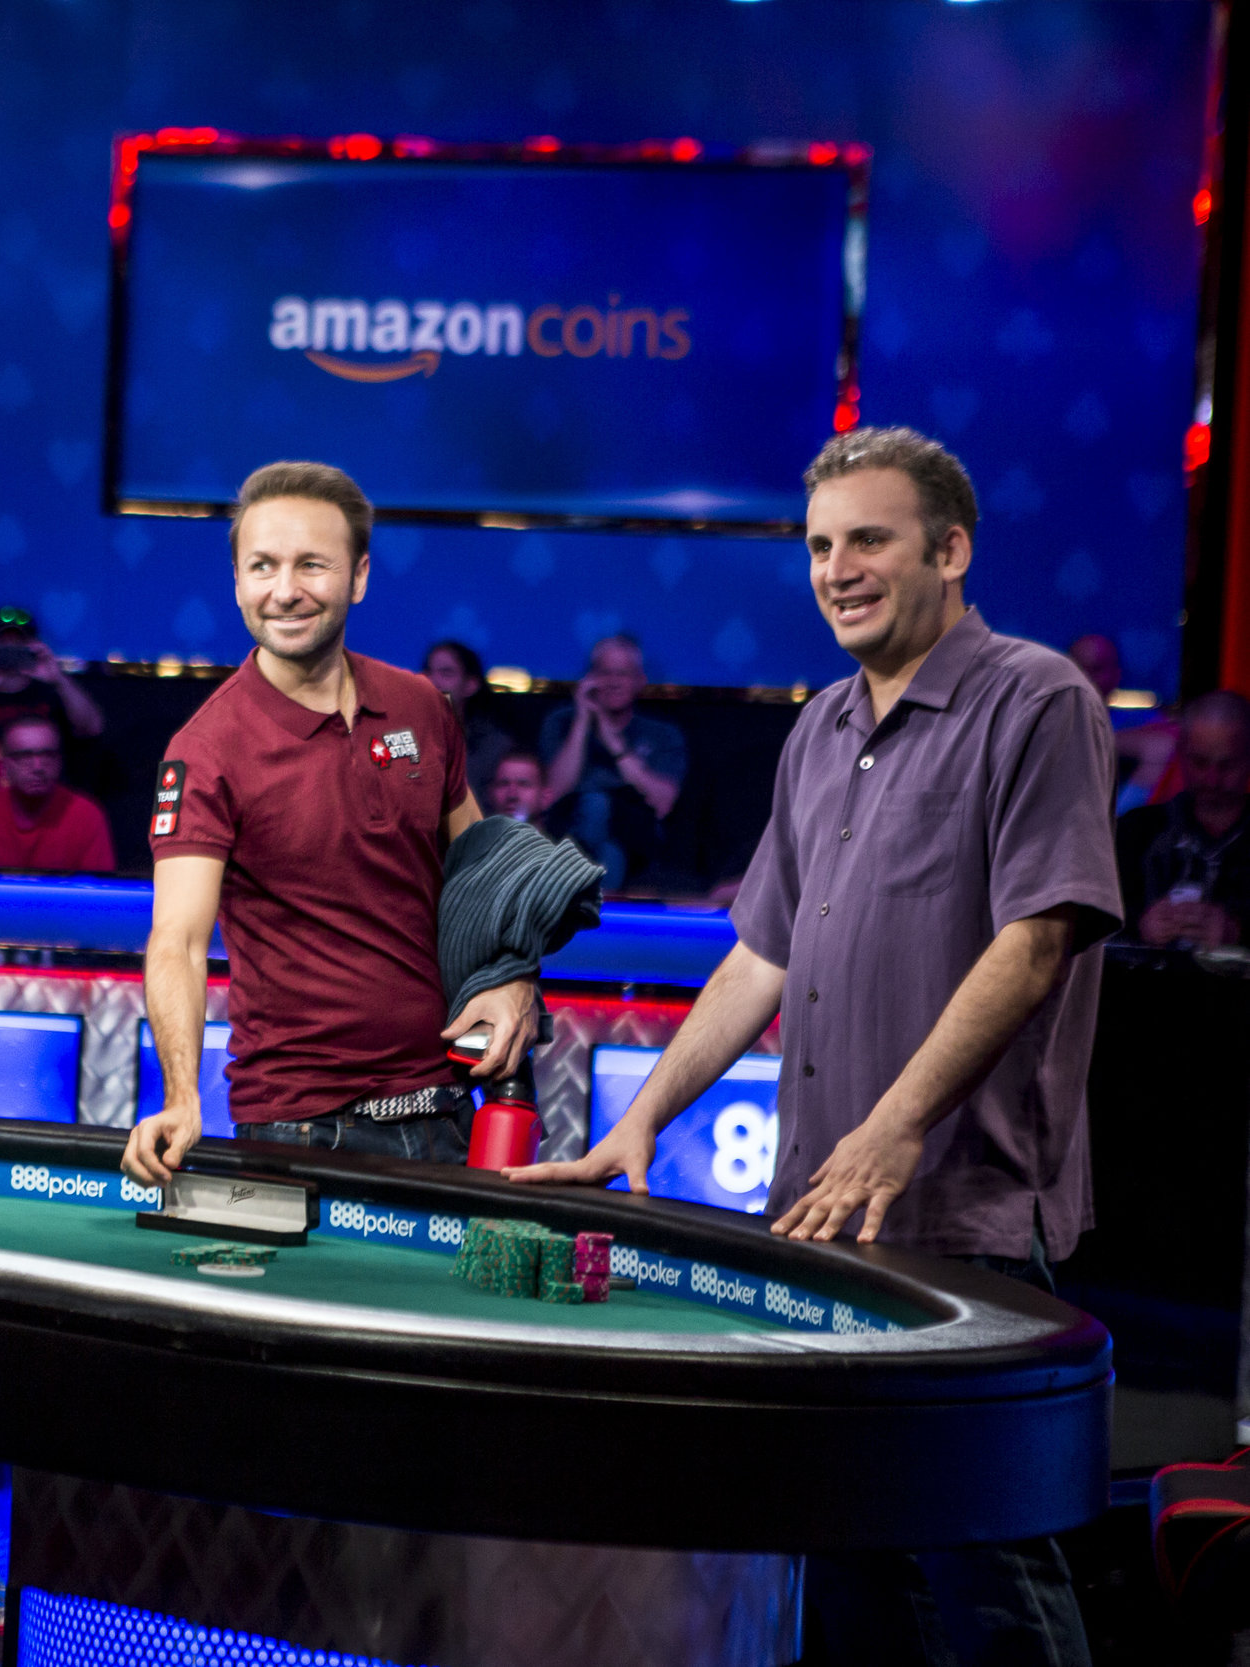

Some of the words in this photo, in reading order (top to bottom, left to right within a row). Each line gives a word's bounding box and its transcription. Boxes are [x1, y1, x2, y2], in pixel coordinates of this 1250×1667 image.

[158, 791, 179, 803] TEAM
[10, 1163, 108, 1199] 888poker
[329, 1200, 418, 1237] 888poker
[609, 1245, 682, 1287] 888poker
[690, 1262, 757, 1304] 888poker
[764, 1280, 827, 1324] 888poker
